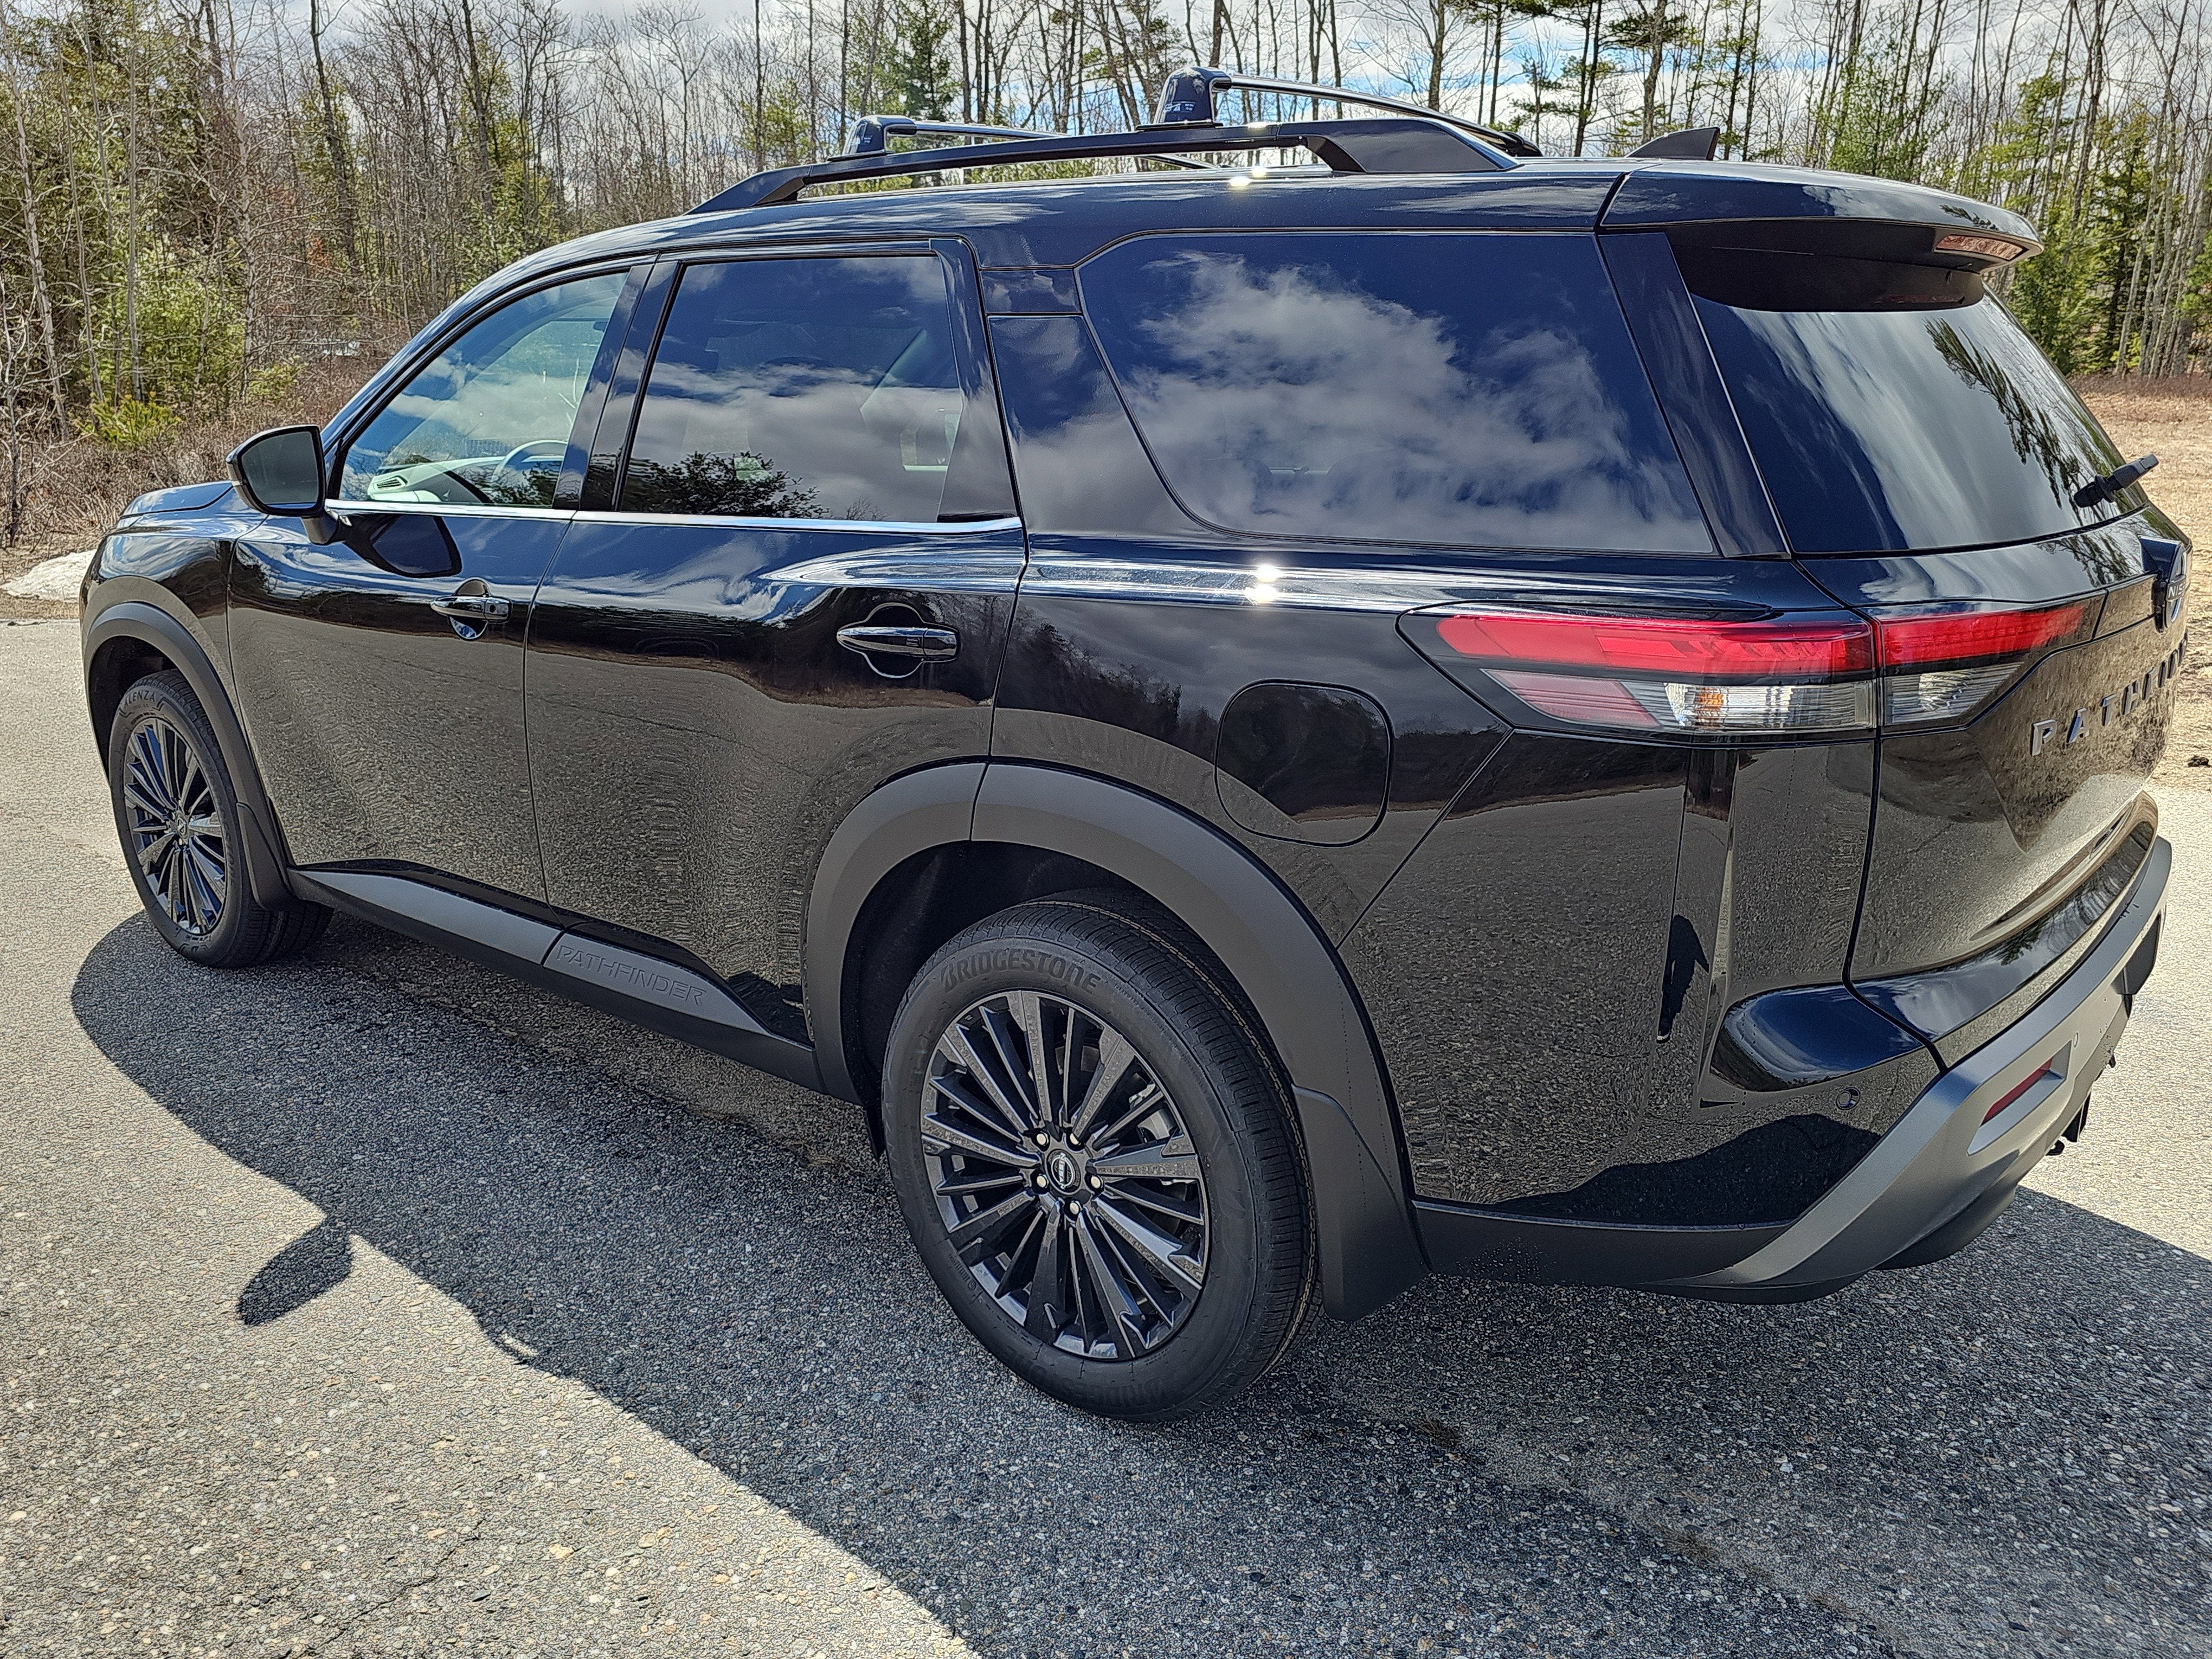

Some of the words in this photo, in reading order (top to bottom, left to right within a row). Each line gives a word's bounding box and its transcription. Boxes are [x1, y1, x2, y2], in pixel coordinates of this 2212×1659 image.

[2168, 582, 2185, 599] NIS
[124, 690, 155, 708] ALENZA
[556, 944, 708, 1007] PATHFINDER
[940, 948, 1102, 994] BRIDGESTONE
[1058, 1152, 1066, 1189] NISSAN
